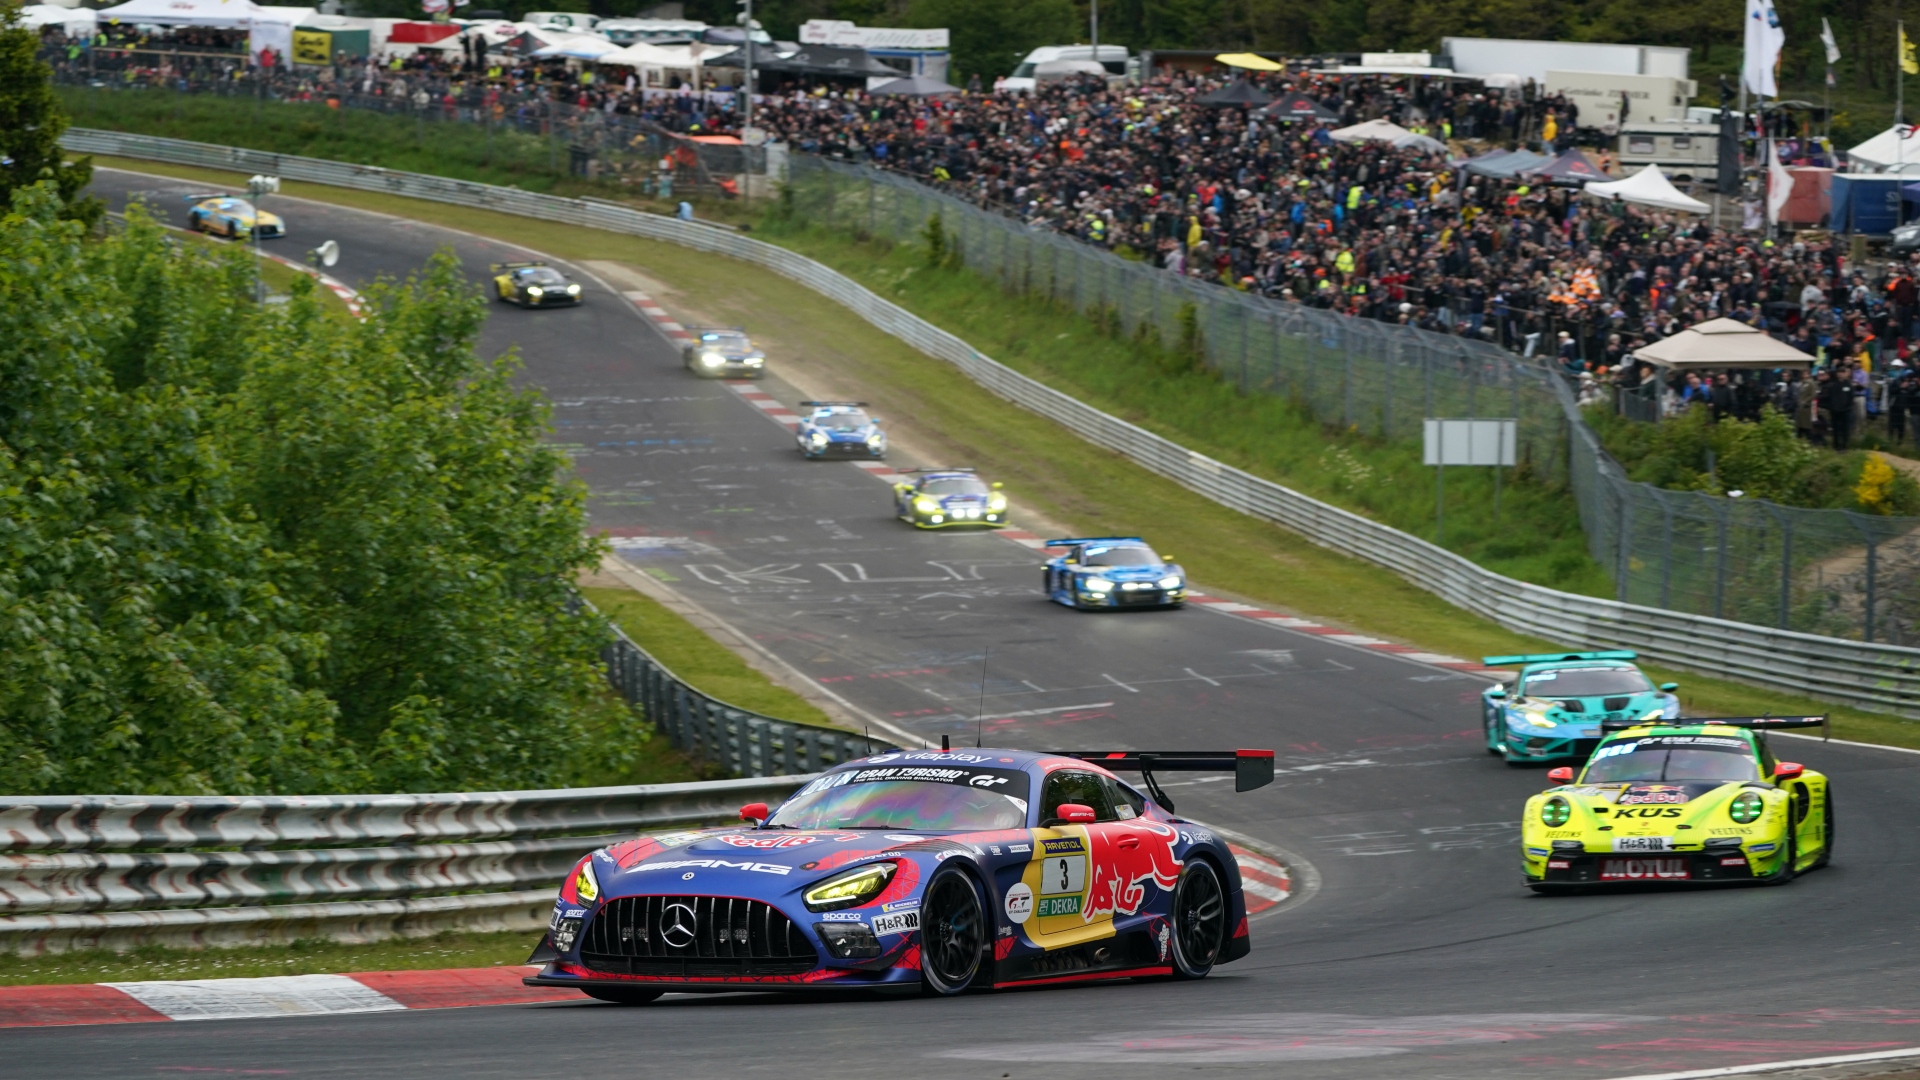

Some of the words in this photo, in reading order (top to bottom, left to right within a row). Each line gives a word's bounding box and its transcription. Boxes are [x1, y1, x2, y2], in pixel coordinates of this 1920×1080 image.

[905, 753, 992, 763] viaplay
[855, 768, 898, 779] GRAN
[1613, 808, 1683, 819] KÜS
[1709, 827, 1753, 836] VELTINS
[1045, 840, 1081, 851] RAVENOL
[678, 859, 792, 875] AMG
[1602, 858, 1688, 879] MOTUL
[1060, 859, 1069, 890] 3
[1051, 897, 1079, 914] DEKRA
[822, 912, 862, 921] sparco
